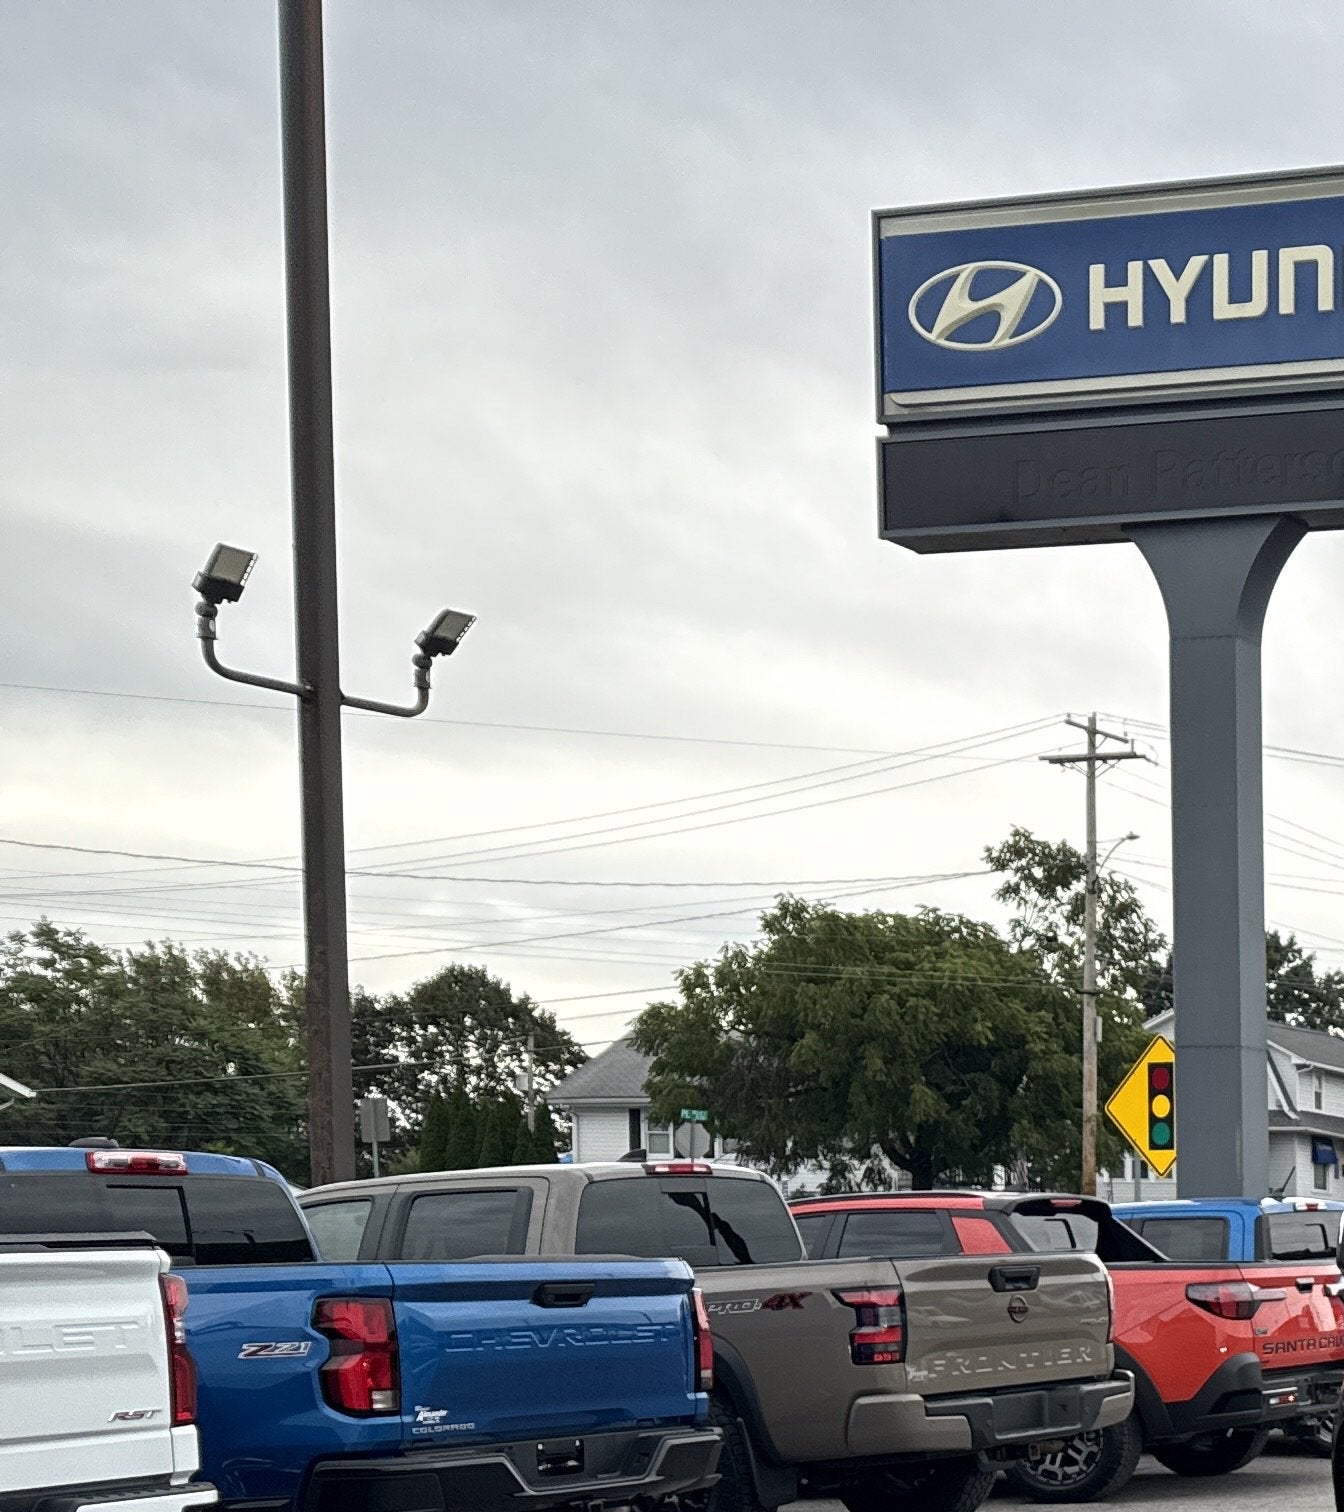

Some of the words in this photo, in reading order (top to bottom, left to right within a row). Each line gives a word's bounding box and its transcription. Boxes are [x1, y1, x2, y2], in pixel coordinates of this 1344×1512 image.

[445, 1324, 675, 1352] CHEVROLET
[1262, 1338, 1316, 1355] SANTA
[237, 1341, 312, 1359] Z71
[928, 1347, 1092, 1378] FRONTIER
[106, 1408, 162, 1423] RST
[411, 1422, 475, 1435] COLORADO
